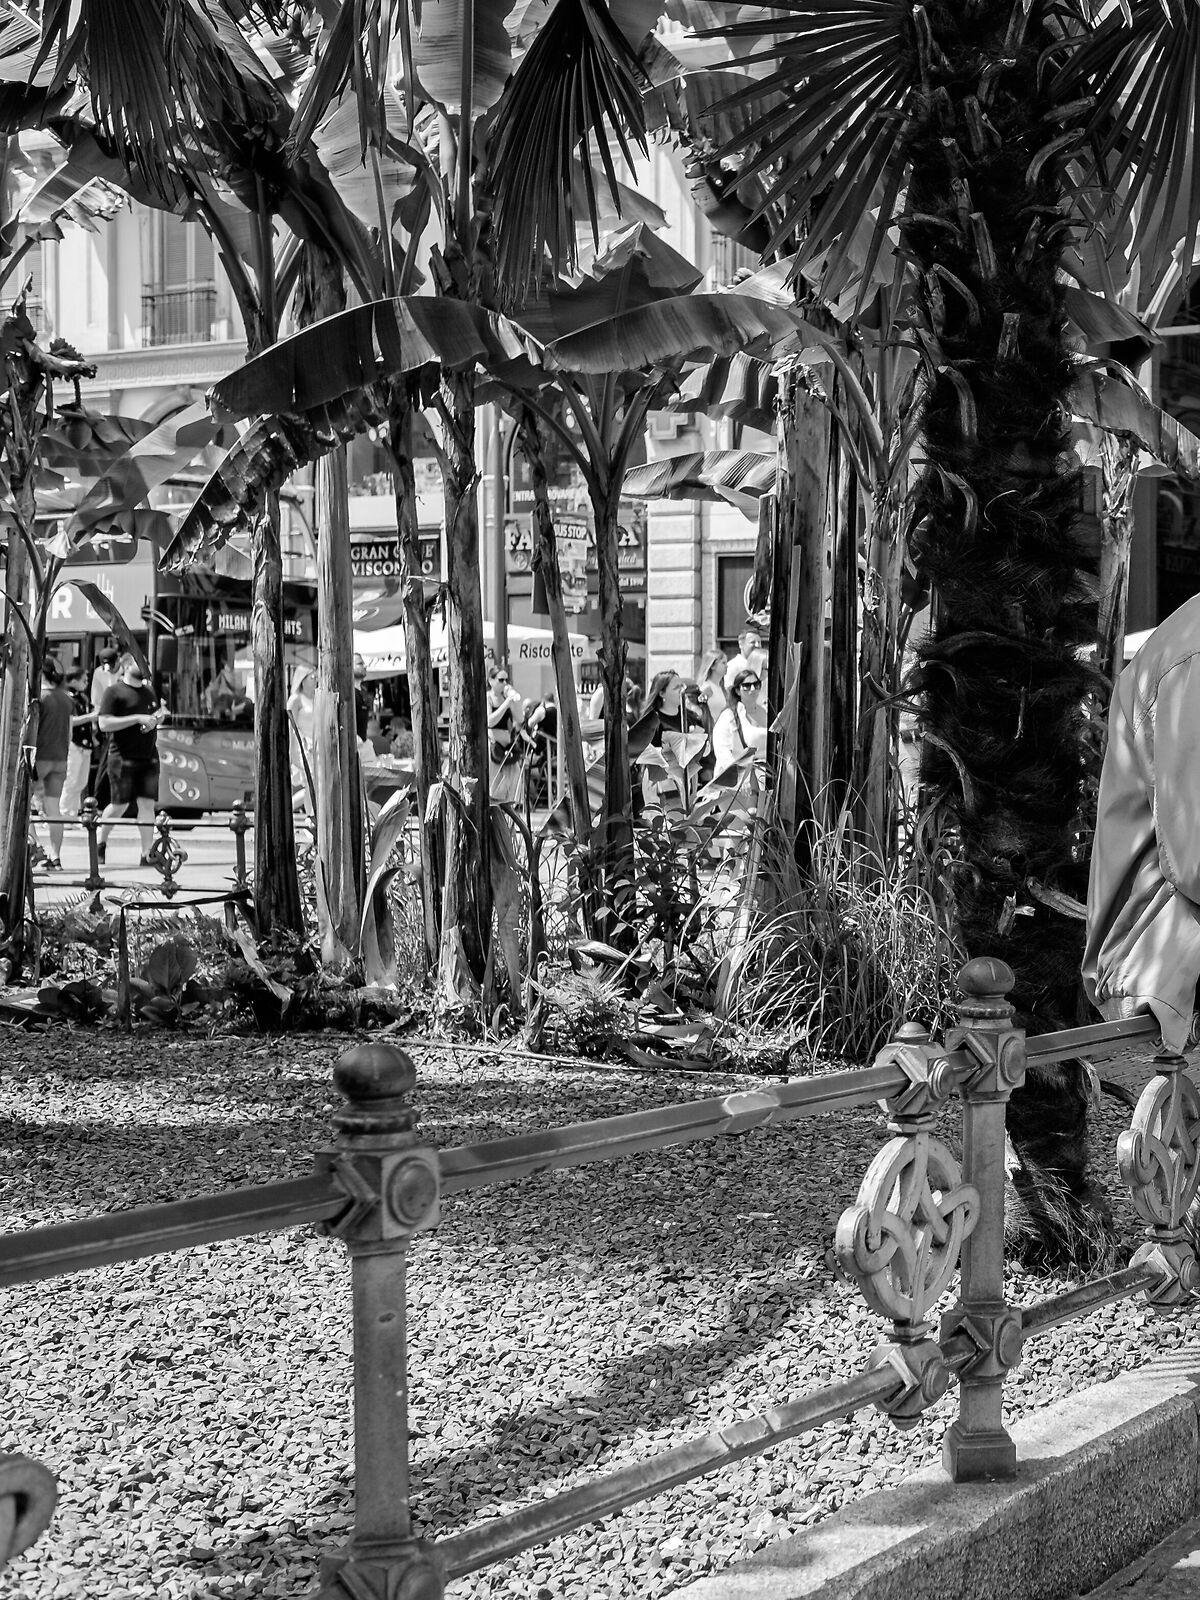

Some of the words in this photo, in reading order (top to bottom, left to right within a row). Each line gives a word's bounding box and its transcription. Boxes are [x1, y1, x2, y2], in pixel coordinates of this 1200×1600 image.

[568, 526, 587, 539] STOP
[350, 545, 389, 560] GRAN
[351, 560, 433, 577] VISCONO
[519, 643, 584, 659] Ristote
